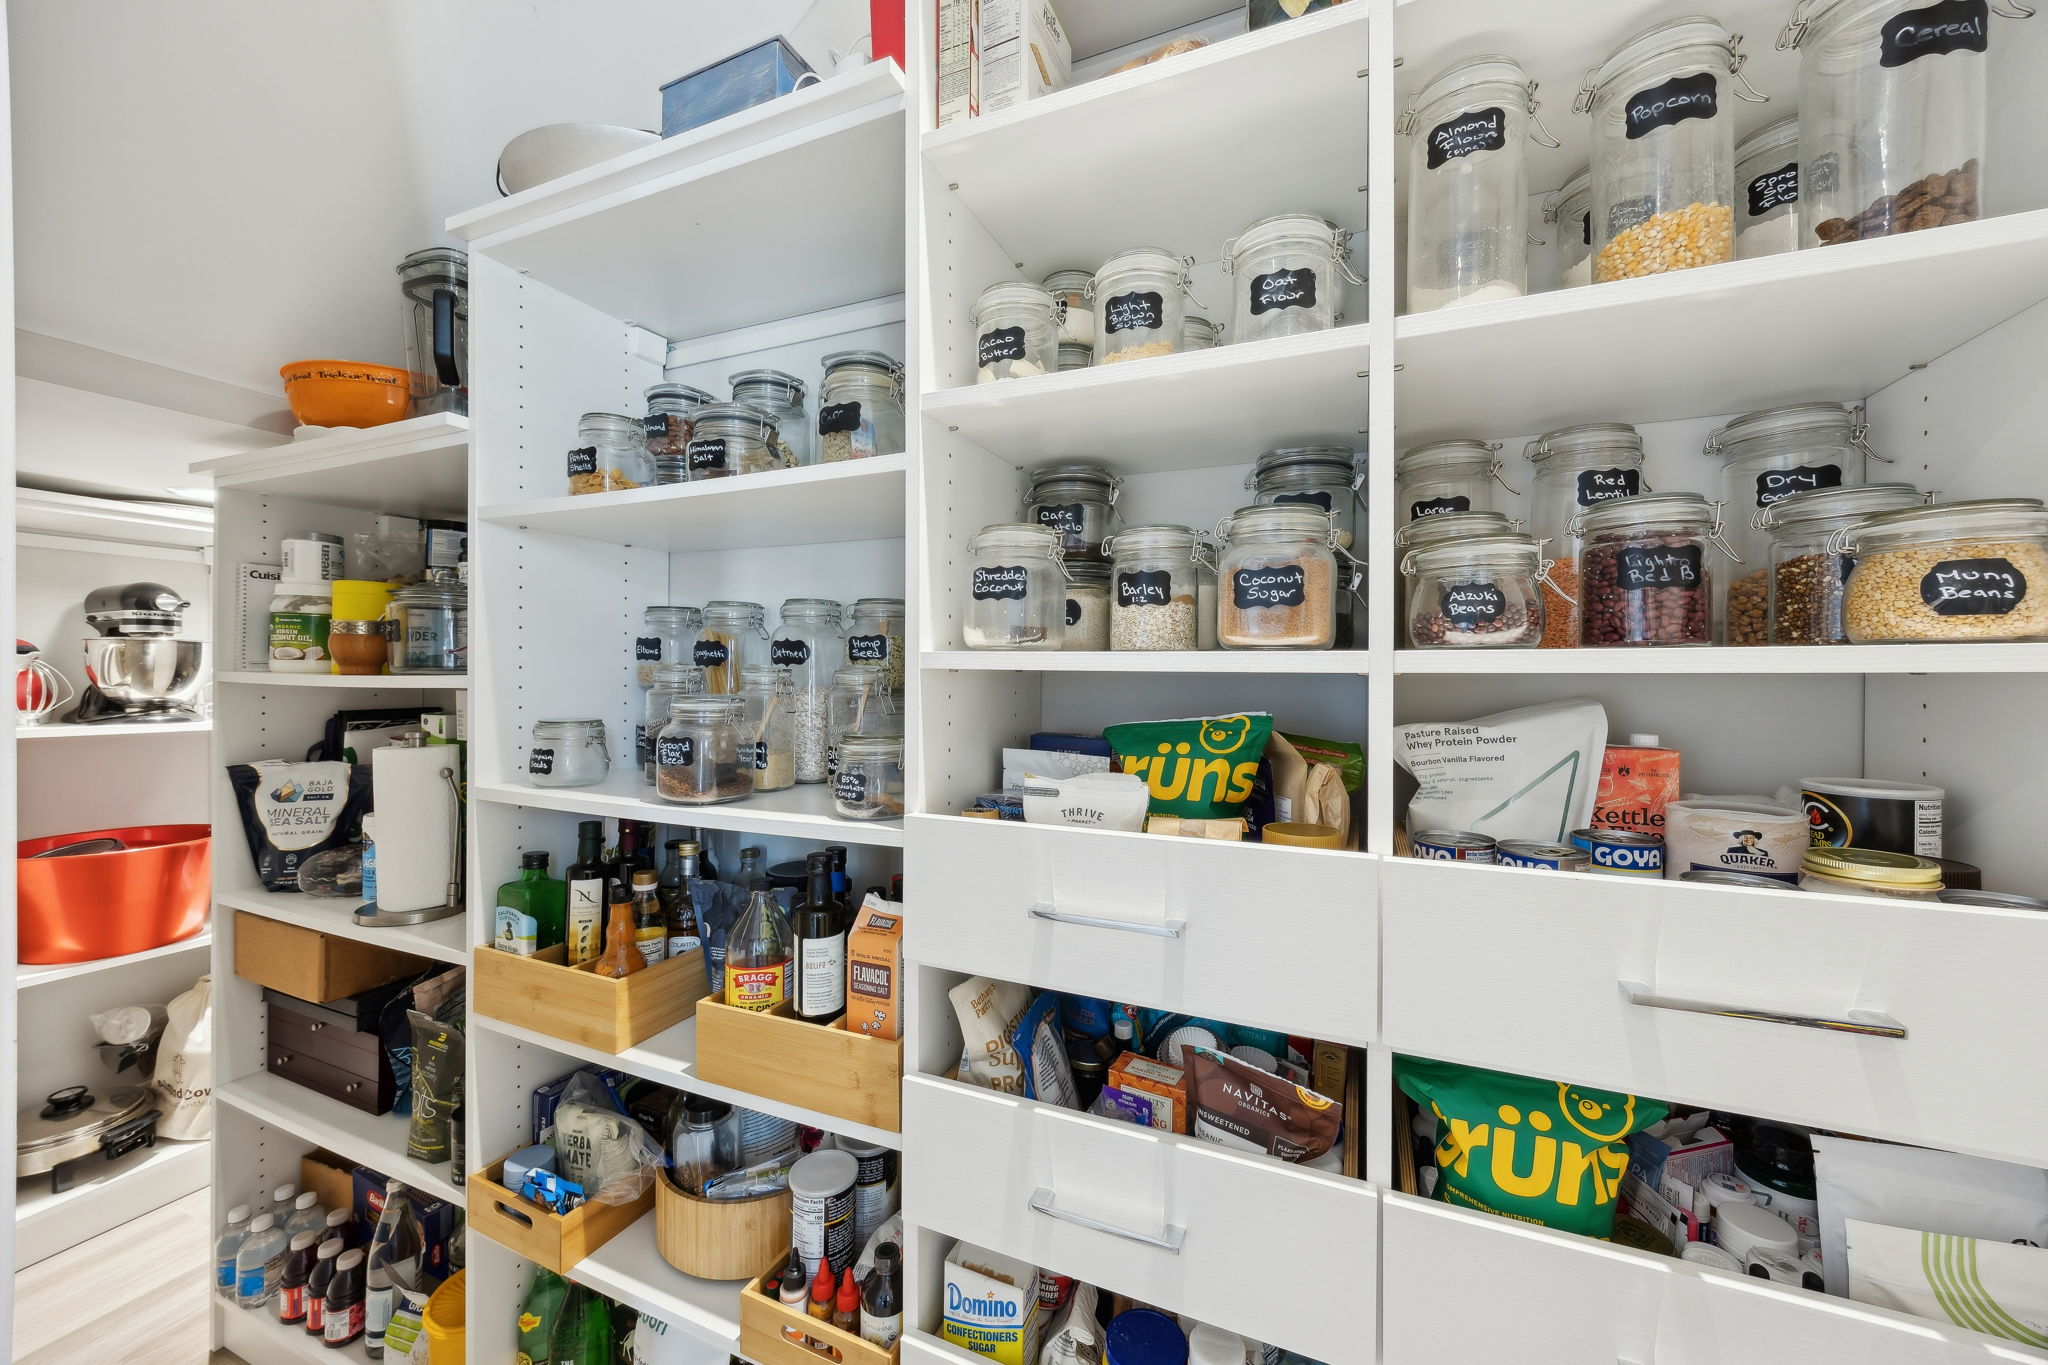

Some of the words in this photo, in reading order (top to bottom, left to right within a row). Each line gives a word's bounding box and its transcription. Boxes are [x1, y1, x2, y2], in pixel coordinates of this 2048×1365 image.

[1895, 16, 1984, 47] Cereal
[1631, 93, 1712, 124] Popcorn
[1435, 115, 1497, 145] Almond
[1439, 130, 1499, 150] Flour
[1755, 171, 1798, 191] Spro
[1262, 275, 1298, 290] Oat
[1259, 289, 1305, 306] Flour
[1110, 299, 1151, 315] Light
[1109, 309, 1155, 325] Brown
[1114, 317, 1153, 332] Sugar
[980, 334, 1015, 351] Cacao
[980, 345, 1018, 361] Butter
[317, 370, 346, 379] Trick
[363, 373, 398, 385] Treat
[689, 444, 725, 456] Himalayan
[693, 454, 714, 464] Salt
[570, 463, 593, 472] Shells
[1593, 473, 1626, 486] Red
[1766, 472, 1818, 489] Dry
[1040, 510, 1073, 521] Cafe
[249, 569, 281, 581] Cuisi
[975, 569, 1029, 582] Shredded
[1239, 571, 1304, 587] Coconut
[1680, 565, 1695, 581] B
[1935, 567, 2016, 588] Mung
[974, 580, 1025, 593] Coconut
[1122, 582, 1165, 600] Barley
[1246, 586, 1297, 602] Sugar
[1940, 585, 2014, 600] Beans
[1449, 587, 1499, 604] Adzuki
[1448, 602, 1496, 616] Beans
[637, 645, 659, 655] Elbows
[853, 638, 881, 650] Hemp
[694, 650, 725, 660] Spaghetti
[772, 645, 808, 659] Oatmeal
[853, 648, 882, 659] Seed
[1404, 728, 1441, 740] Pasture
[1444, 726, 1479, 736] Raised
[658, 740, 690, 751] Ground
[1406, 740, 1433, 751] Whey
[1434, 736, 1473, 747] Protein
[1476, 734, 1518, 745] Powder
[660, 750, 680, 758] Flax
[663, 756, 685, 765] Seed
[1410, 758, 1442, 768] Bourbon
[1441, 755, 1468, 763] Vanilla
[1469, 754, 1505, 763] Flavored
[530, 760, 548, 769] Seeds
[841, 774, 860, 785] 85%
[1121, 742, 1258, 804] rüns
[309, 779, 334, 787] BAJA
[267, 806, 331, 818] MINERAL
[1061, 807, 1105, 822] THRIVE
[1591, 806, 1665, 828] Kettle
[270, 817, 291, 827] SEA
[294, 815, 331, 826] SALT
[1810, 830, 1825, 840] EAD
[1811, 839, 1832, 848] UMBS
[1594, 846, 1661, 868] GOYA
[1720, 853, 1776, 870] QUAKER
[498, 909, 521, 921] CALIFORNIA
[870, 915, 895, 929] FLAVACOL
[738, 973, 773, 982] BRAGG
[853, 965, 889, 986] FLAVACOL
[853, 982, 877, 993] SEASONING
[877, 986, 888, 995] SALT
[1238, 1030, 1267, 1041] WEETENER
[1130, 1065, 1155, 1077] BAKING
[1156, 1071, 1175, 1081] SODA
[990, 1071, 1025, 1093] PRO
[1222, 1083, 1288, 1121] NAVITAS
[1237, 1101, 1271, 1118] ORGANICS
[1198, 1109, 1250, 1136] NSWEETENED
[1200, 1129, 1224, 1145] GANIC
[1446, 1184, 1500, 1216] MPREHENSIVE
[1501, 1211, 1544, 1228] NUTRITION
[1041, 1283, 1059, 1292] KING
[408, 1300, 425, 1314] GRA
[947, 1282, 1018, 1318] Domino
[946, 1323, 1019, 1343] CONFECTIONERS
[968, 1340, 996, 1353] SUGAR
